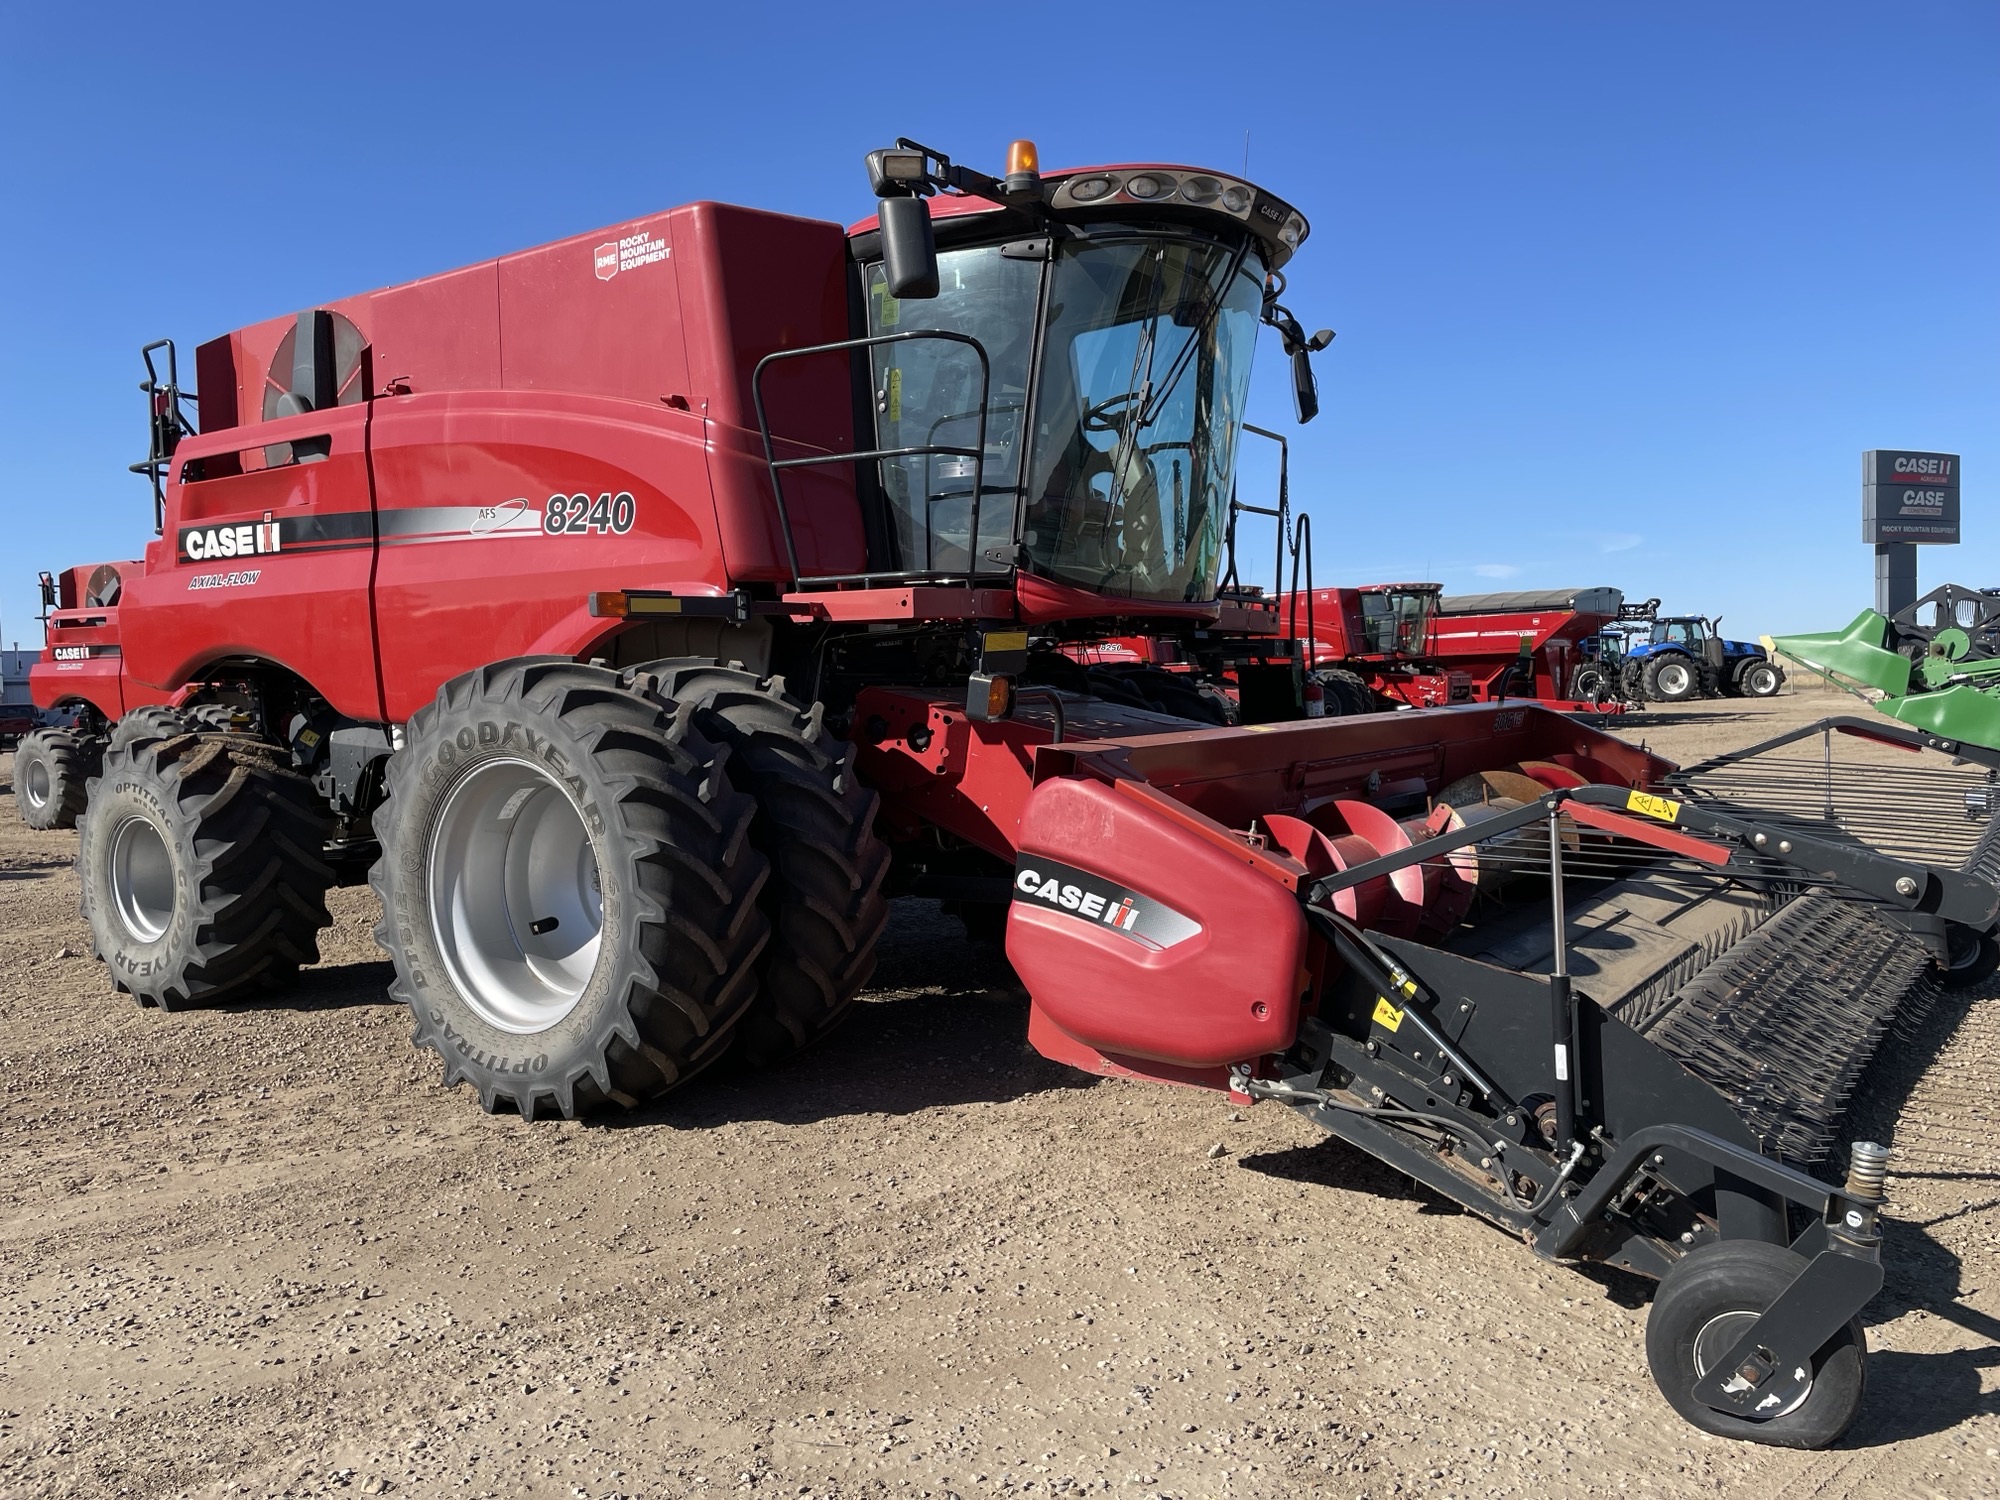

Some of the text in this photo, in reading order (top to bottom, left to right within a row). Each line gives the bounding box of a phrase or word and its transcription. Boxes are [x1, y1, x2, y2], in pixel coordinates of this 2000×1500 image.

[1261, 205, 1279, 220] CASE
[620, 232, 649, 249] ROCKY
[620, 239, 665, 260] MOUNTAIN
[597, 253, 617, 268] RME
[620, 248, 671, 271] EQUIPMENT
[1894, 457, 1938, 474] CASE
[1903, 490, 1945, 506] CASE
[478, 508, 496, 519] AFS
[544, 491, 636, 536] 8240
[1881, 525, 1956, 534] ROCKY MOUNTAIN EQUIPMENT
[185, 525, 255, 560] CASE
[188, 570, 261, 590] AXIAL-FLOW
[55, 647, 80, 661] CASE
[115, 782, 173, 830] OPTITRAC
[1016, 869, 1107, 919] CASE
[430, 1008, 549, 1076] OPTITRAC
